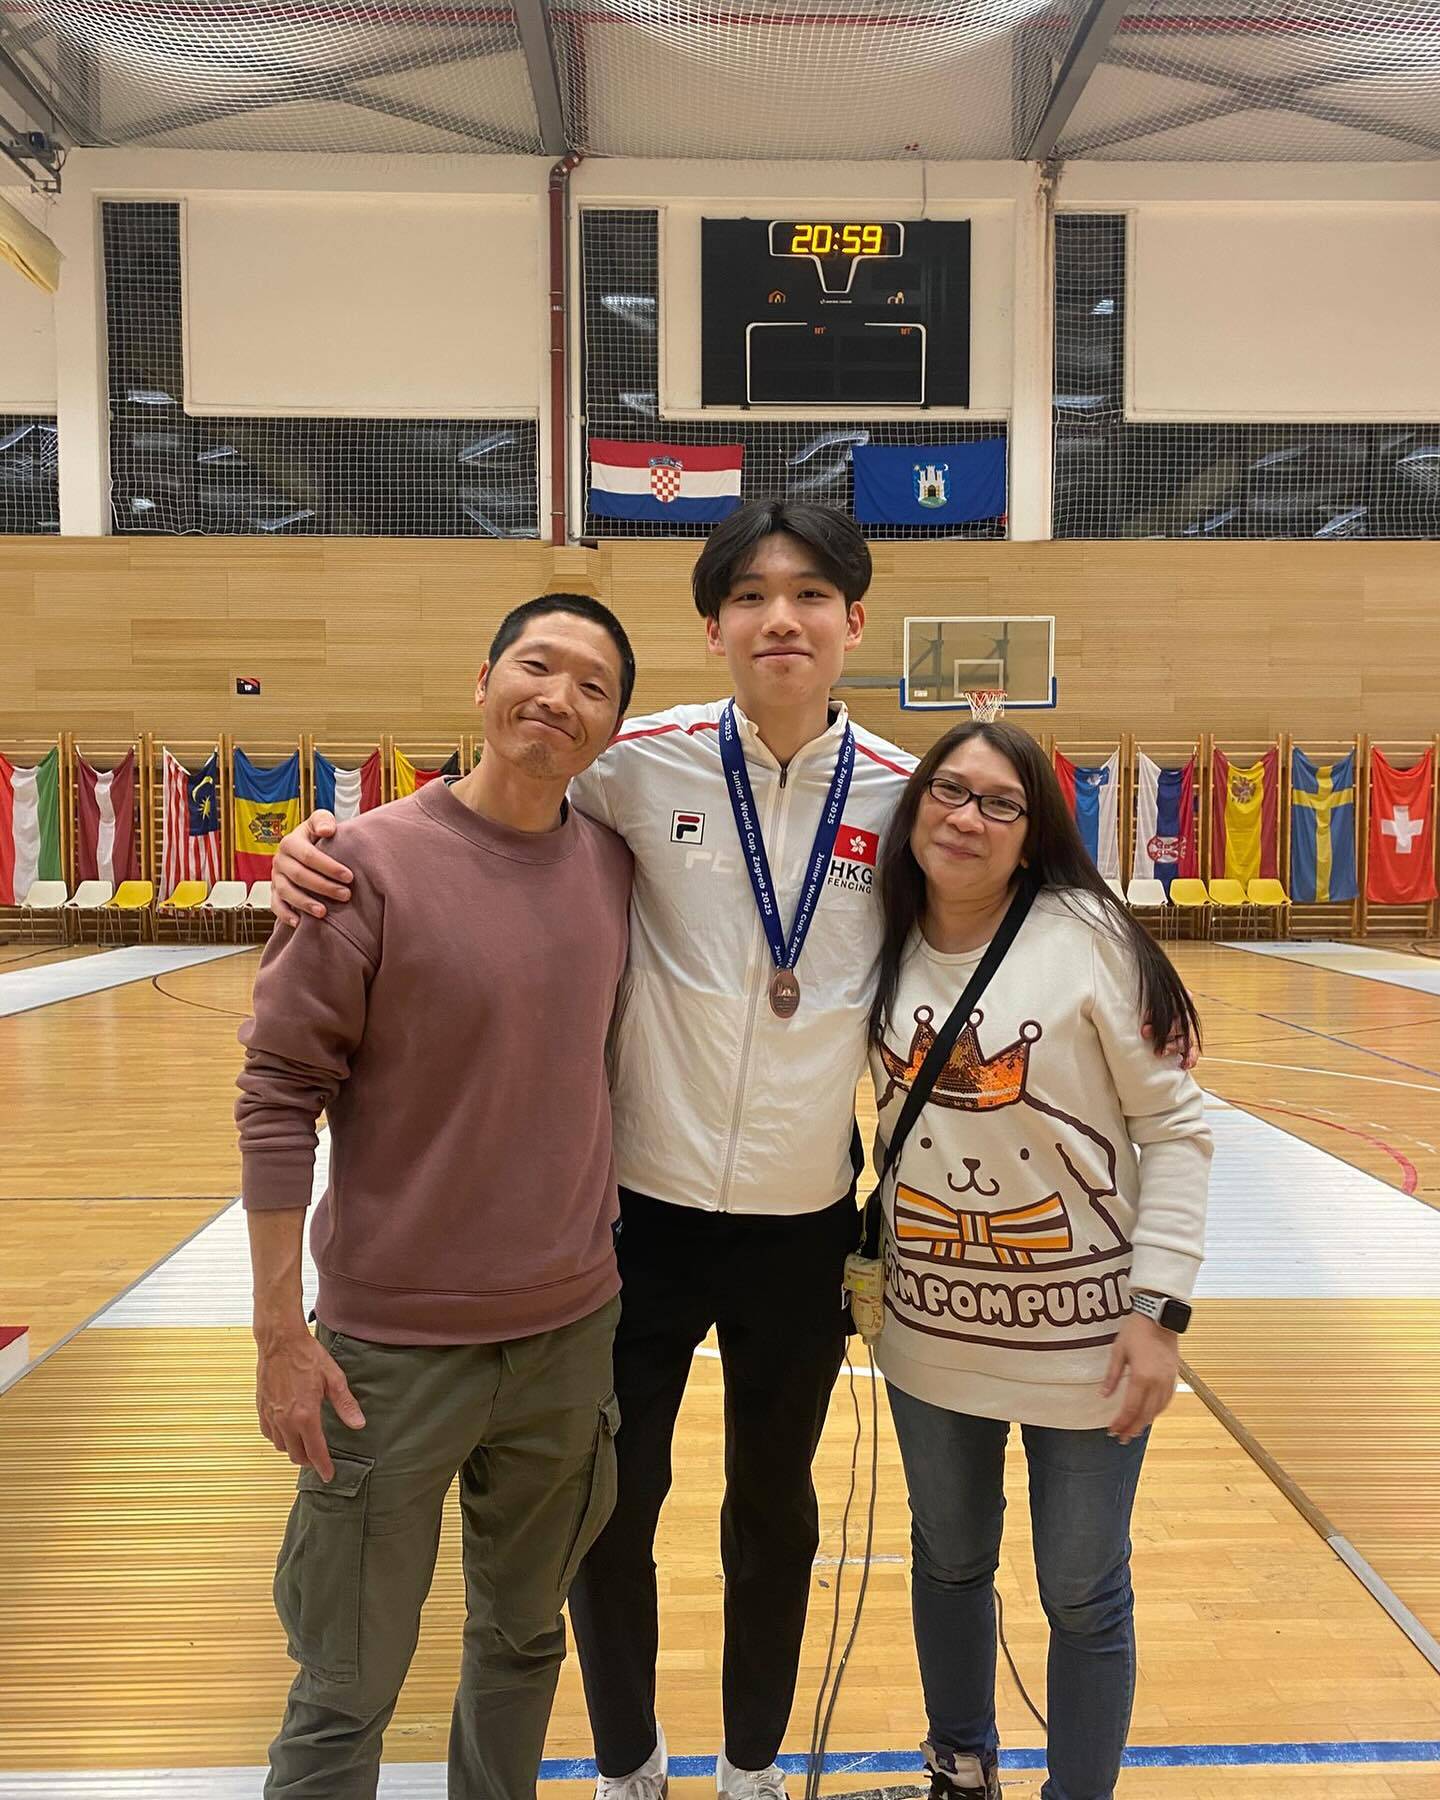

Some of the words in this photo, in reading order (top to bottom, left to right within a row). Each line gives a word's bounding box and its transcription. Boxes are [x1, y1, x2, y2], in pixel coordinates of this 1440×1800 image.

[791, 224, 883, 254] 20:59
[725, 719, 733, 741] 2025
[842, 745, 851, 765] Cup,
[834, 767, 848, 799] Zagreb
[827, 801, 839, 825] 2025
[732, 770, 744, 799] Junior
[740, 801, 753, 831] World
[747, 832, 757, 853] Cup,
[752, 855, 765, 889] Zagreb
[761, 891, 773, 916] 2025
[812, 852, 825, 883] Junior
[829, 860, 873, 886] HKG
[803, 884, 816, 912] World
[827, 877, 872, 894] FENCING
